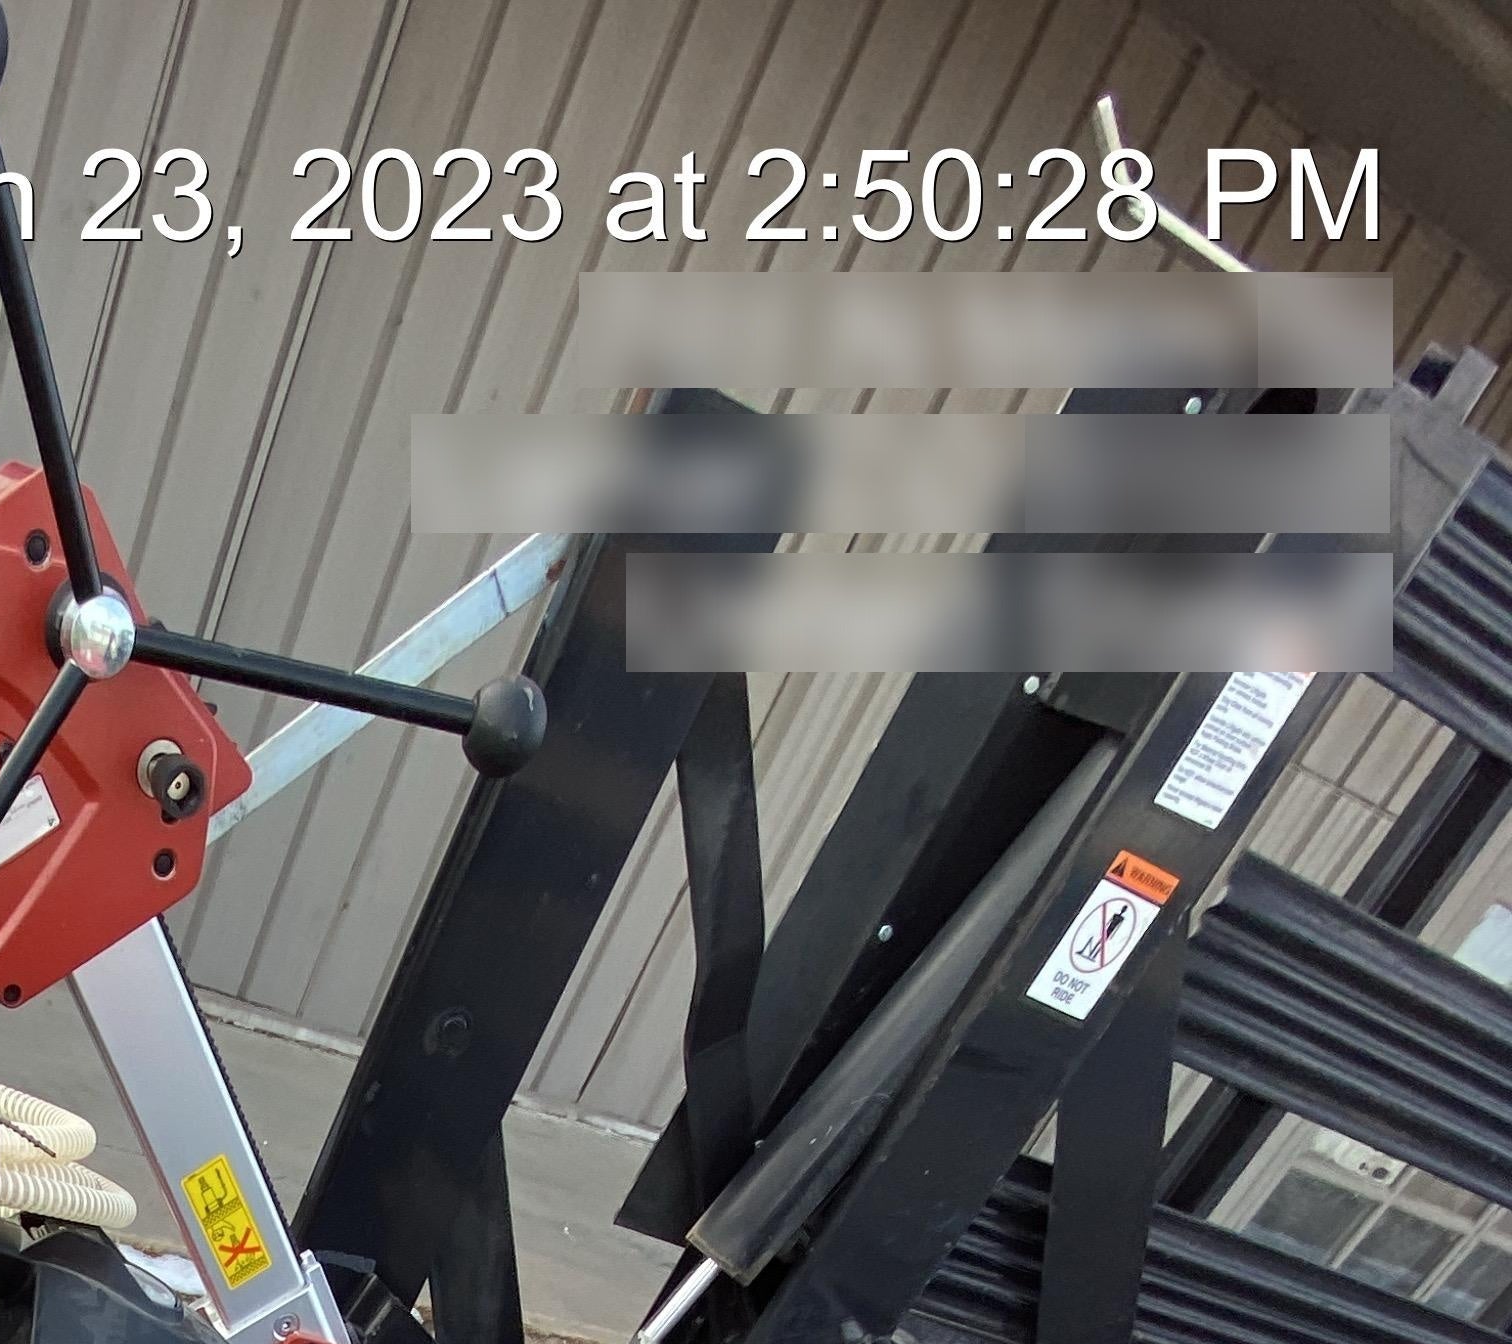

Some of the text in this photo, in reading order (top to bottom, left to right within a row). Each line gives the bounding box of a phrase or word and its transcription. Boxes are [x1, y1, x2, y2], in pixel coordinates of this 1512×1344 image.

[1052, 970, 1090, 994] DO NOT
[1051, 987, 1075, 1005] RIDE
